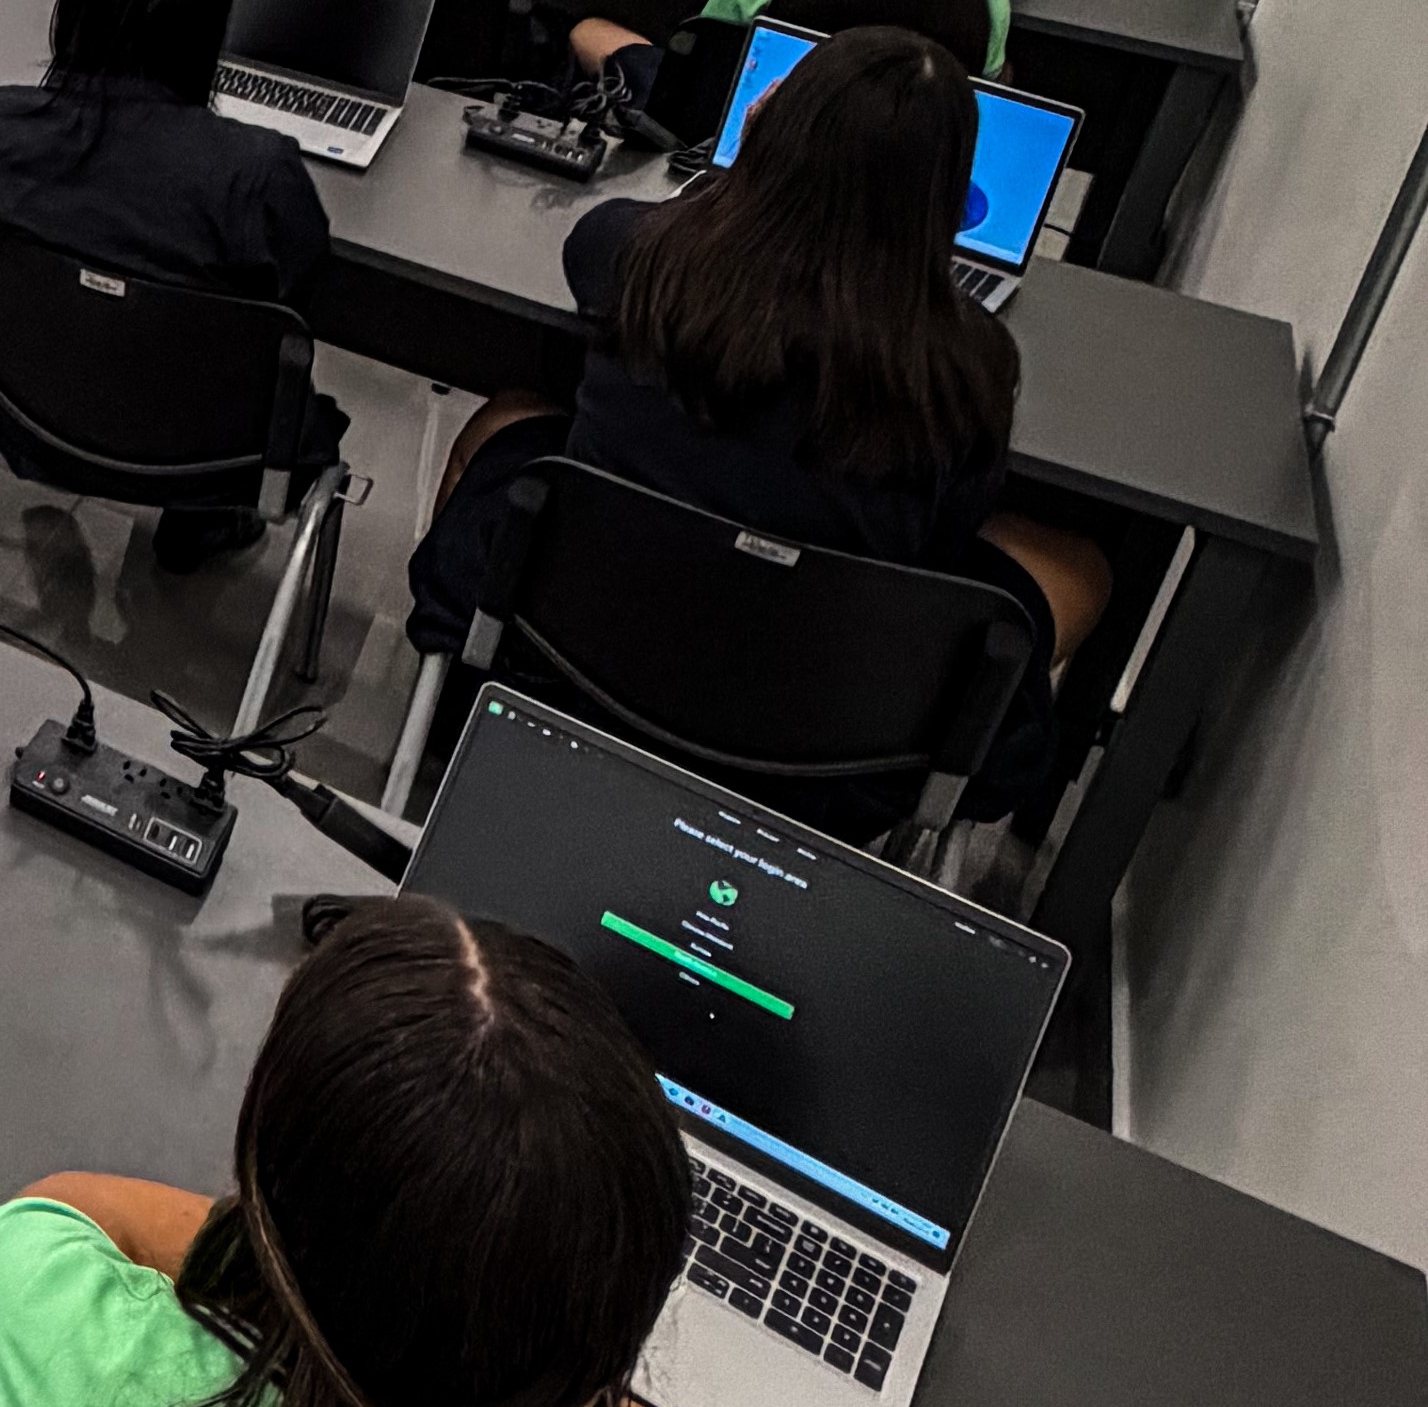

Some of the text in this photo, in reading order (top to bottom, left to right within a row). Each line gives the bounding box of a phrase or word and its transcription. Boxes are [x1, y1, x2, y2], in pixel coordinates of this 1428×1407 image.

[673, 817, 705, 840] Please
[705, 835, 734, 853] select
[733, 849, 759, 866] your
[758, 858, 785, 878] login
[784, 873, 808, 889] area
